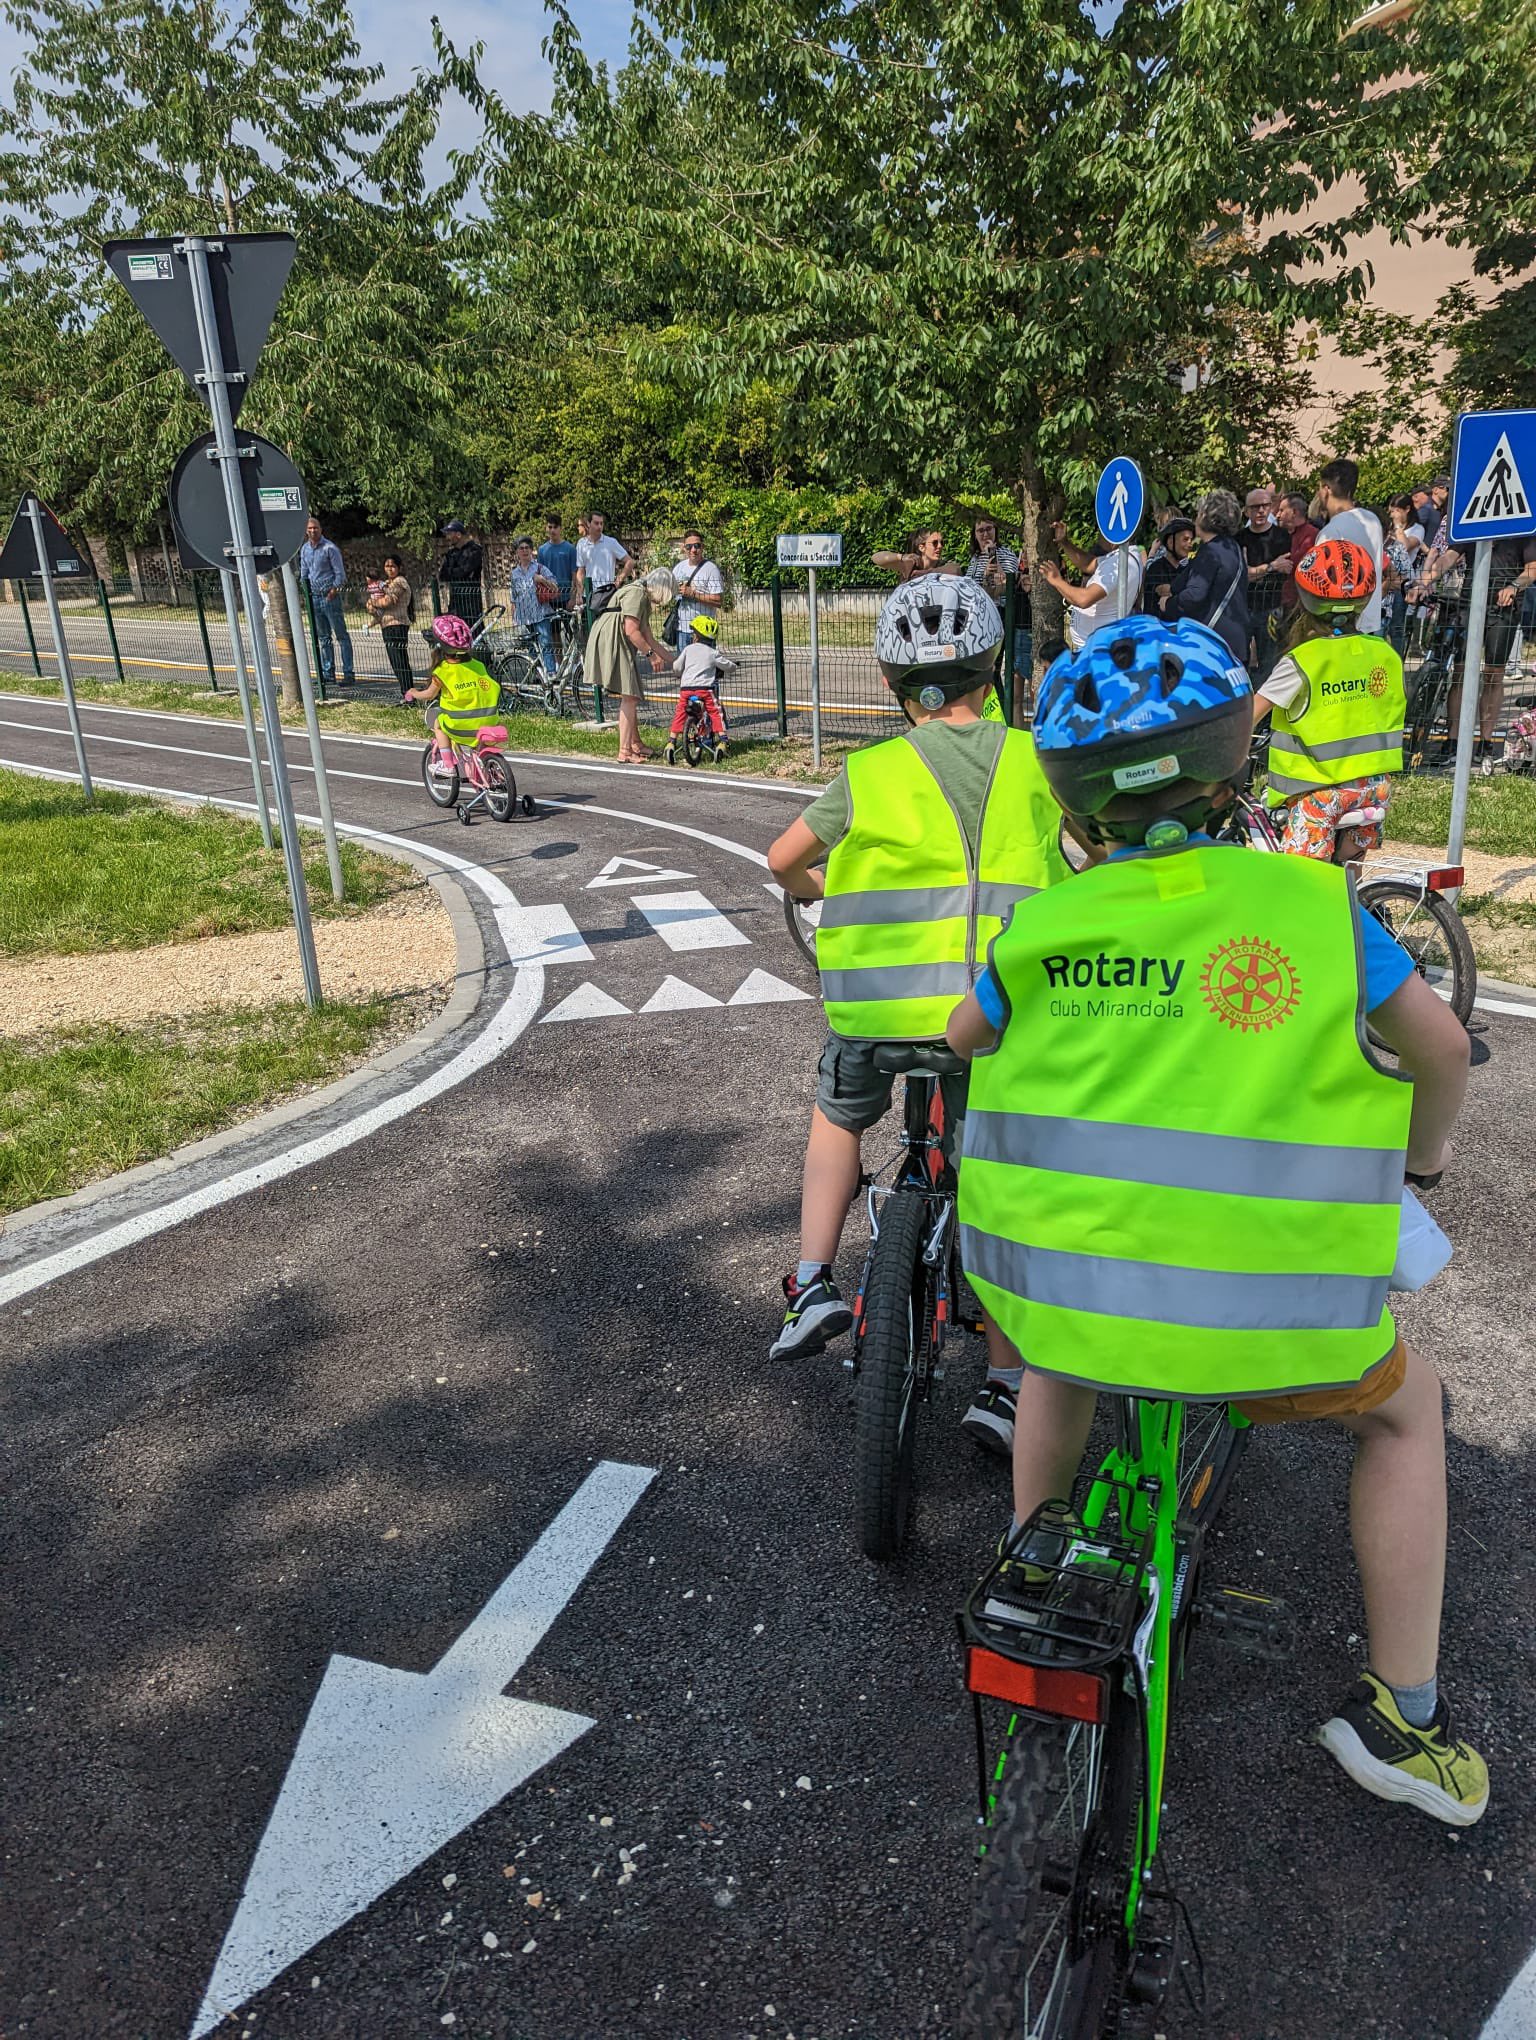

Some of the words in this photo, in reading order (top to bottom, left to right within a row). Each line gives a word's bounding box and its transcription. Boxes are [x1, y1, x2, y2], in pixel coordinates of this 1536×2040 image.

[804, 538, 813, 546] via
[780, 552, 809, 562] Concordia
[924, 649, 942, 657] Rotary
[454, 680, 477, 691] Rotary
[1321, 677, 1367, 698] Rotary
[1322, 698, 1339, 707] Club
[1340, 692, 1369, 704] Mirandola
[1125, 767, 1156, 780] Rotary
[1234, 946, 1277, 961] ROTARY
[1041, 952, 1185, 997] Rotary
[1050, 999, 1081, 1018] Club
[1087, 999, 1184, 1018] Mirandola
[1213, 992, 1285, 1023] INTERNATIONAL
